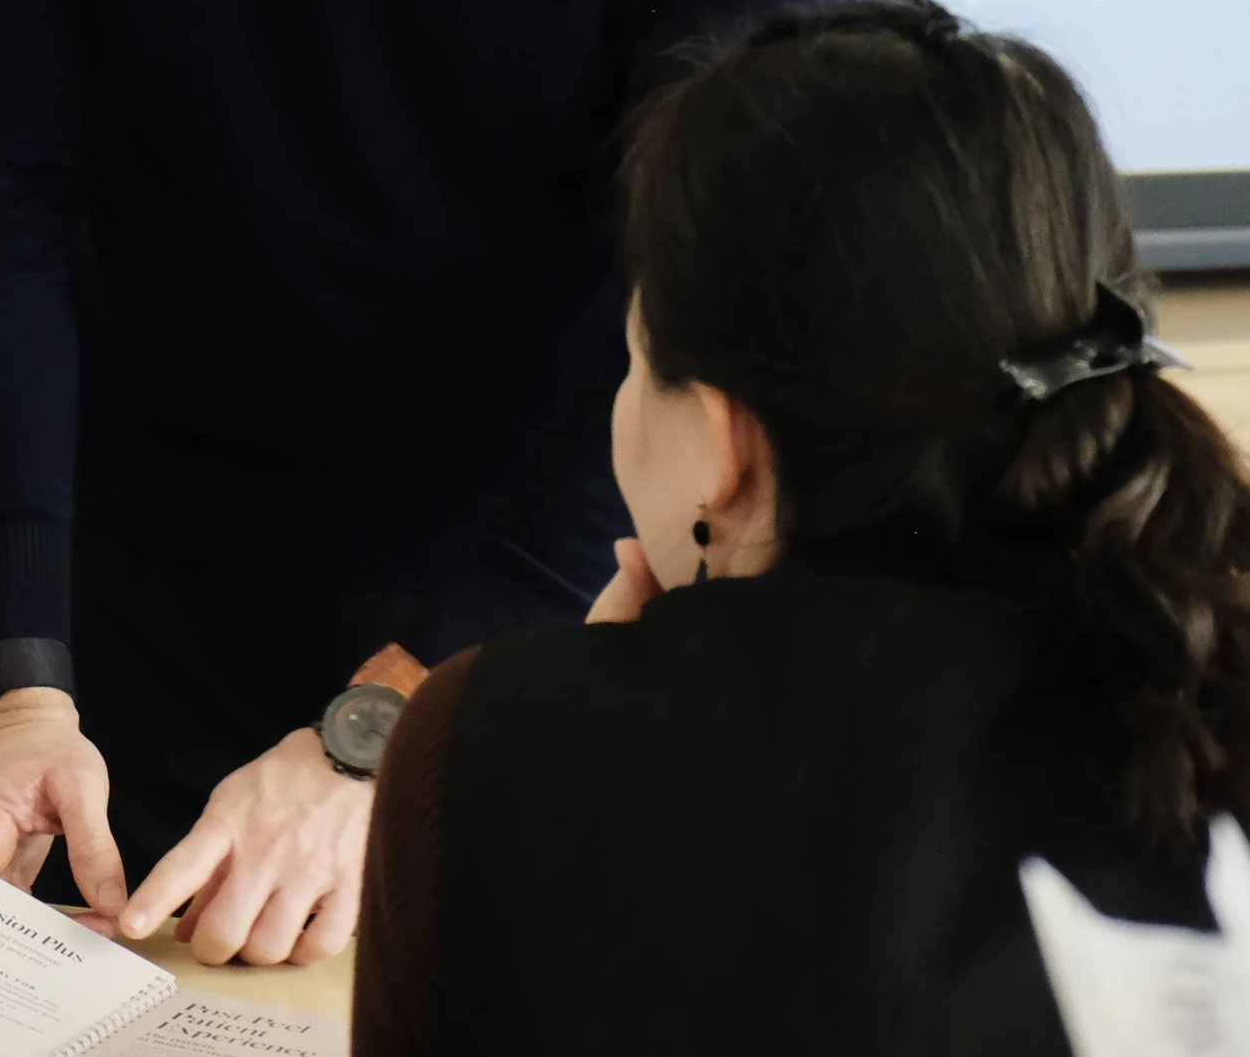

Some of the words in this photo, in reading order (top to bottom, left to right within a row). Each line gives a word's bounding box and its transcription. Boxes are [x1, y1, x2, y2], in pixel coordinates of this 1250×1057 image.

[42, 935, 85, 962] Plus
[172, 1012, 266, 1037] Patient
[184, 1003, 242, 1021] Post
[251, 1016, 311, 1033] Peel
[157, 1021, 317, 1057] Experience
